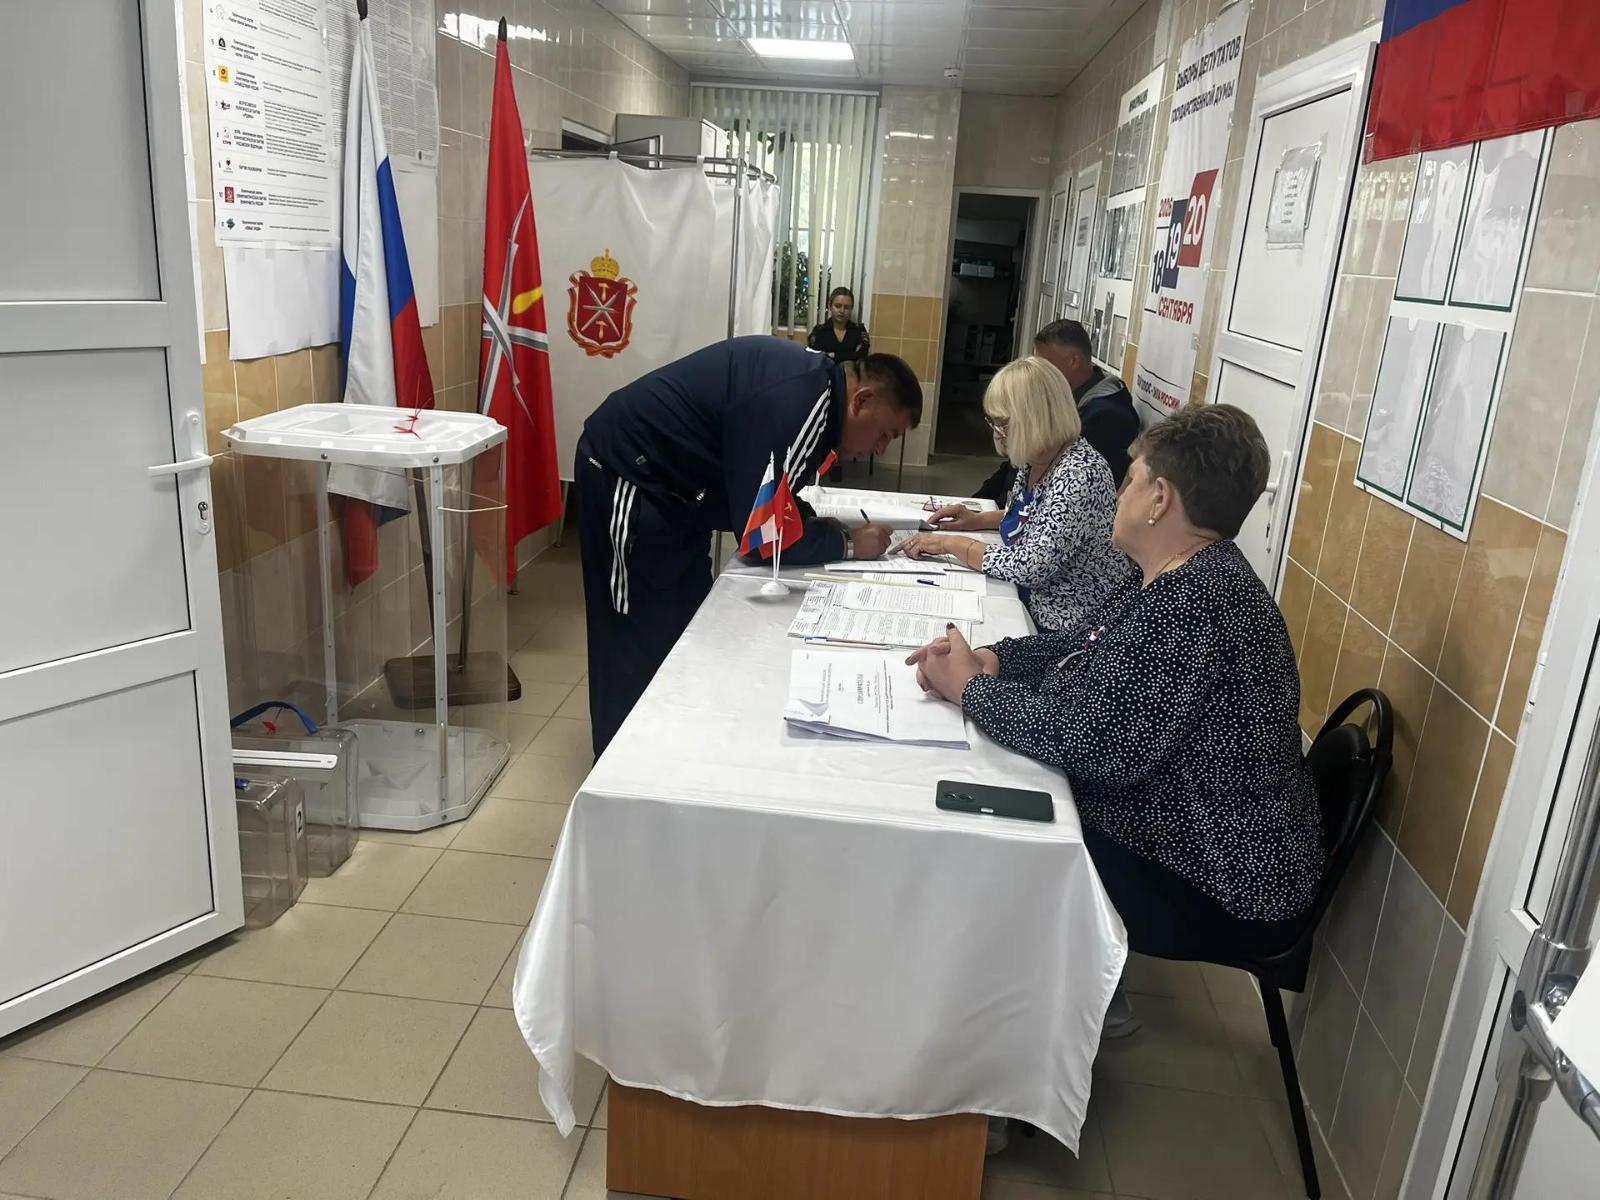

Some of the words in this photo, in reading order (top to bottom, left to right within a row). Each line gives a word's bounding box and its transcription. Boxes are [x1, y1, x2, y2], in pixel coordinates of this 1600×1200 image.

[1176, 60, 1199, 91] ВЫБОРЫ
[1199, 35, 1241, 78] ДЕПУТАТОВ
[1213, 80, 1235, 106] ДУМЫ
[1183, 194, 1206, 246] 20
[1166, 222, 1181, 269] 19
[1151, 250, 1164, 294] 18
[1158, 297, 1193, 325] СЕНТЯБРЯ
